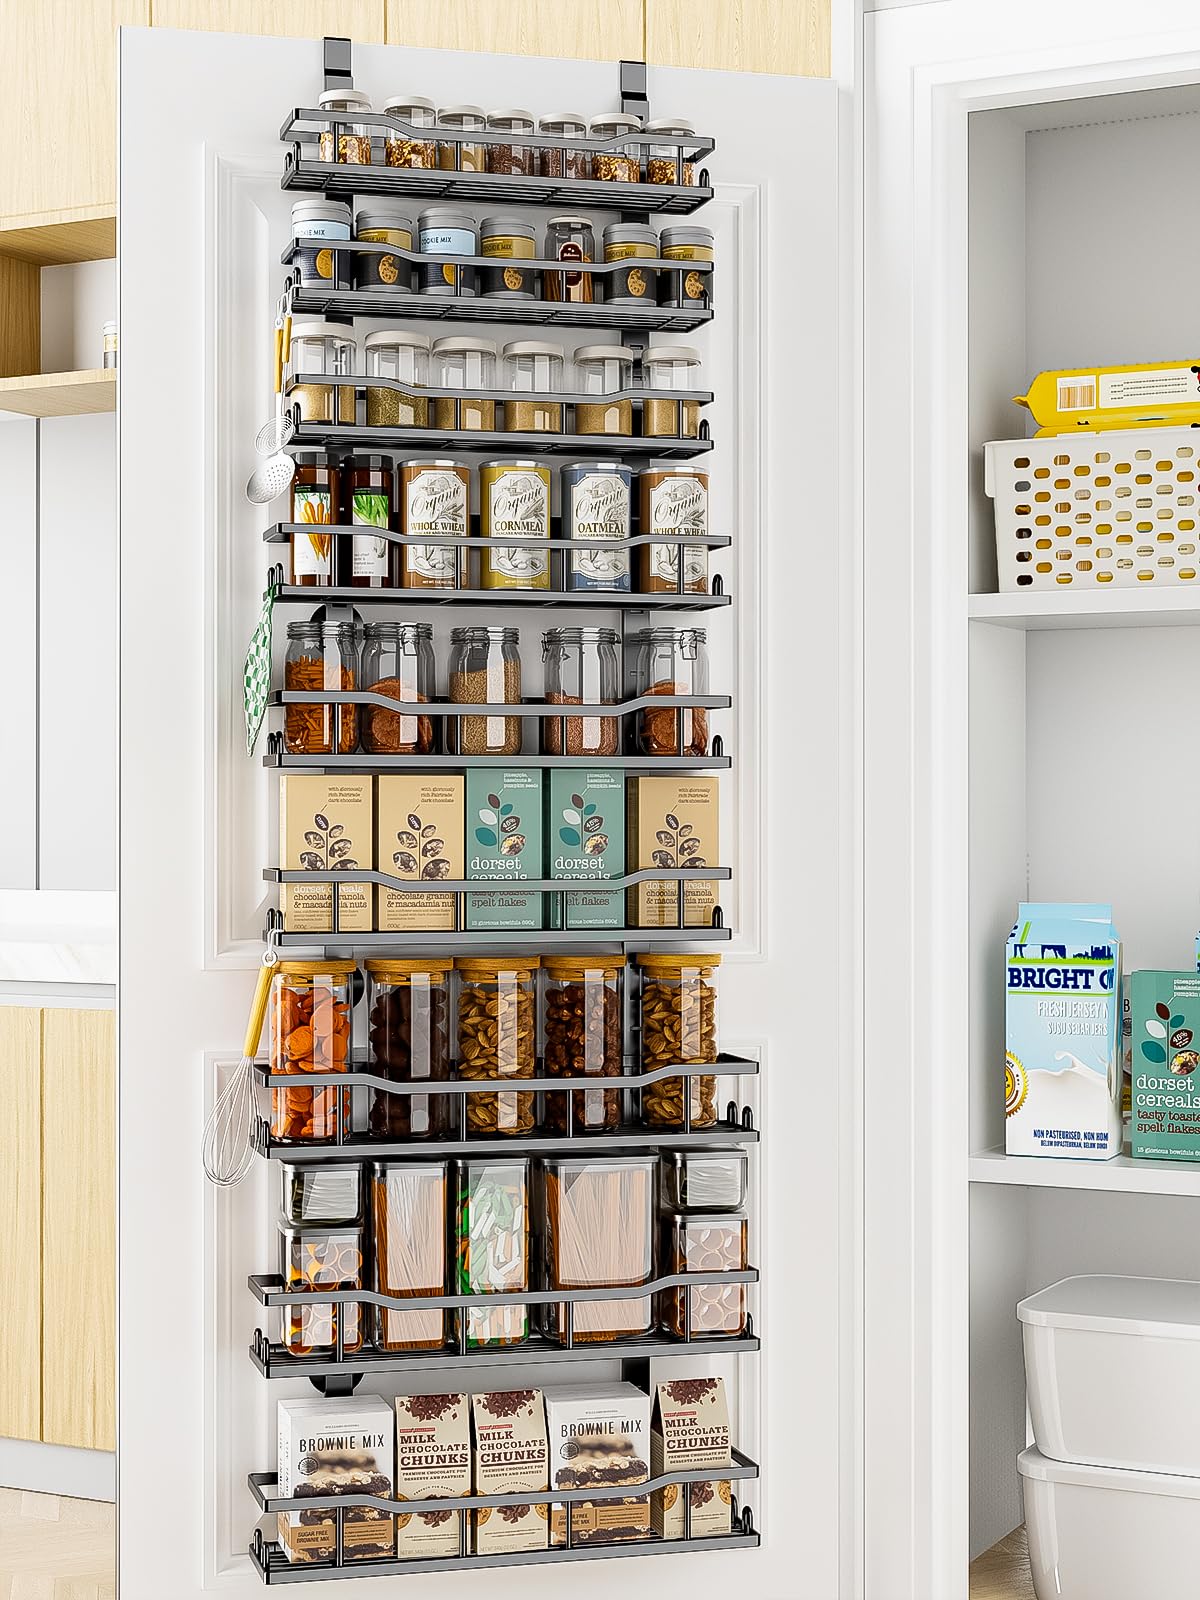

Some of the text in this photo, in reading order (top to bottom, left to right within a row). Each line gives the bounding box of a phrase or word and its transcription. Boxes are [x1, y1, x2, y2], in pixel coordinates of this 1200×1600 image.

[440, 236, 452, 244] MIX
[411, 484, 460, 517] Organic
[494, 485, 542, 517] Organic
[576, 487, 623, 520] Organic
[654, 490, 702, 523] Organic
[411, 521, 465, 532] WHOLE WHEAT
[494, 521, 545, 532] CORNMEAL
[578, 522, 625, 534] OATMEAL
[654, 527, 706, 536] WHOLE WHEAT
[471, 857, 522, 870] dorset
[555, 857, 605, 869] dorset
[293, 885, 326, 893] dorset
[293, 893, 332, 901] chocolate
[471, 897, 527, 908] spelt flakes
[581, 897, 610, 906] flakes
[293, 901, 368, 909] & nuts
[387, 900, 394, 908] &
[442, 900, 455, 908] nut
[1008, 968, 1095, 989] BRIGHT
[1037, 1001, 1067, 1017] FRESH
[1069, 1001, 1100, 1018] JERSEY
[1048, 1022, 1067, 1035] SUSU
[1136, 1074, 1195, 1091] dorset
[1136, 1093, 1200, 1109] cereals
[1137, 1109, 1167, 1122] tasty
[1033, 1129, 1045, 1138] NON
[1083, 1131, 1095, 1140] NON
[1137, 1123, 1200, 1135] spelt flakes
[561, 1420, 642, 1437] BROWNIE MIX
[665, 1418, 698, 1429] MILK
[479, 1431, 514, 1441] MILK
[665, 1426, 729, 1438] CHOCOLATE
[299, 1434, 384, 1453] BROWNIE MIX
[400, 1434, 436, 1444] MILK
[480, 1439, 545, 1451] CHOCOLATE
[666, 1435, 729, 1449] CHUNKS
[400, 1443, 468, 1454] CHOCOLATE
[401, 1453, 468, 1466] CHUNKS
[481, 1449, 546, 1463] CHUNKS
